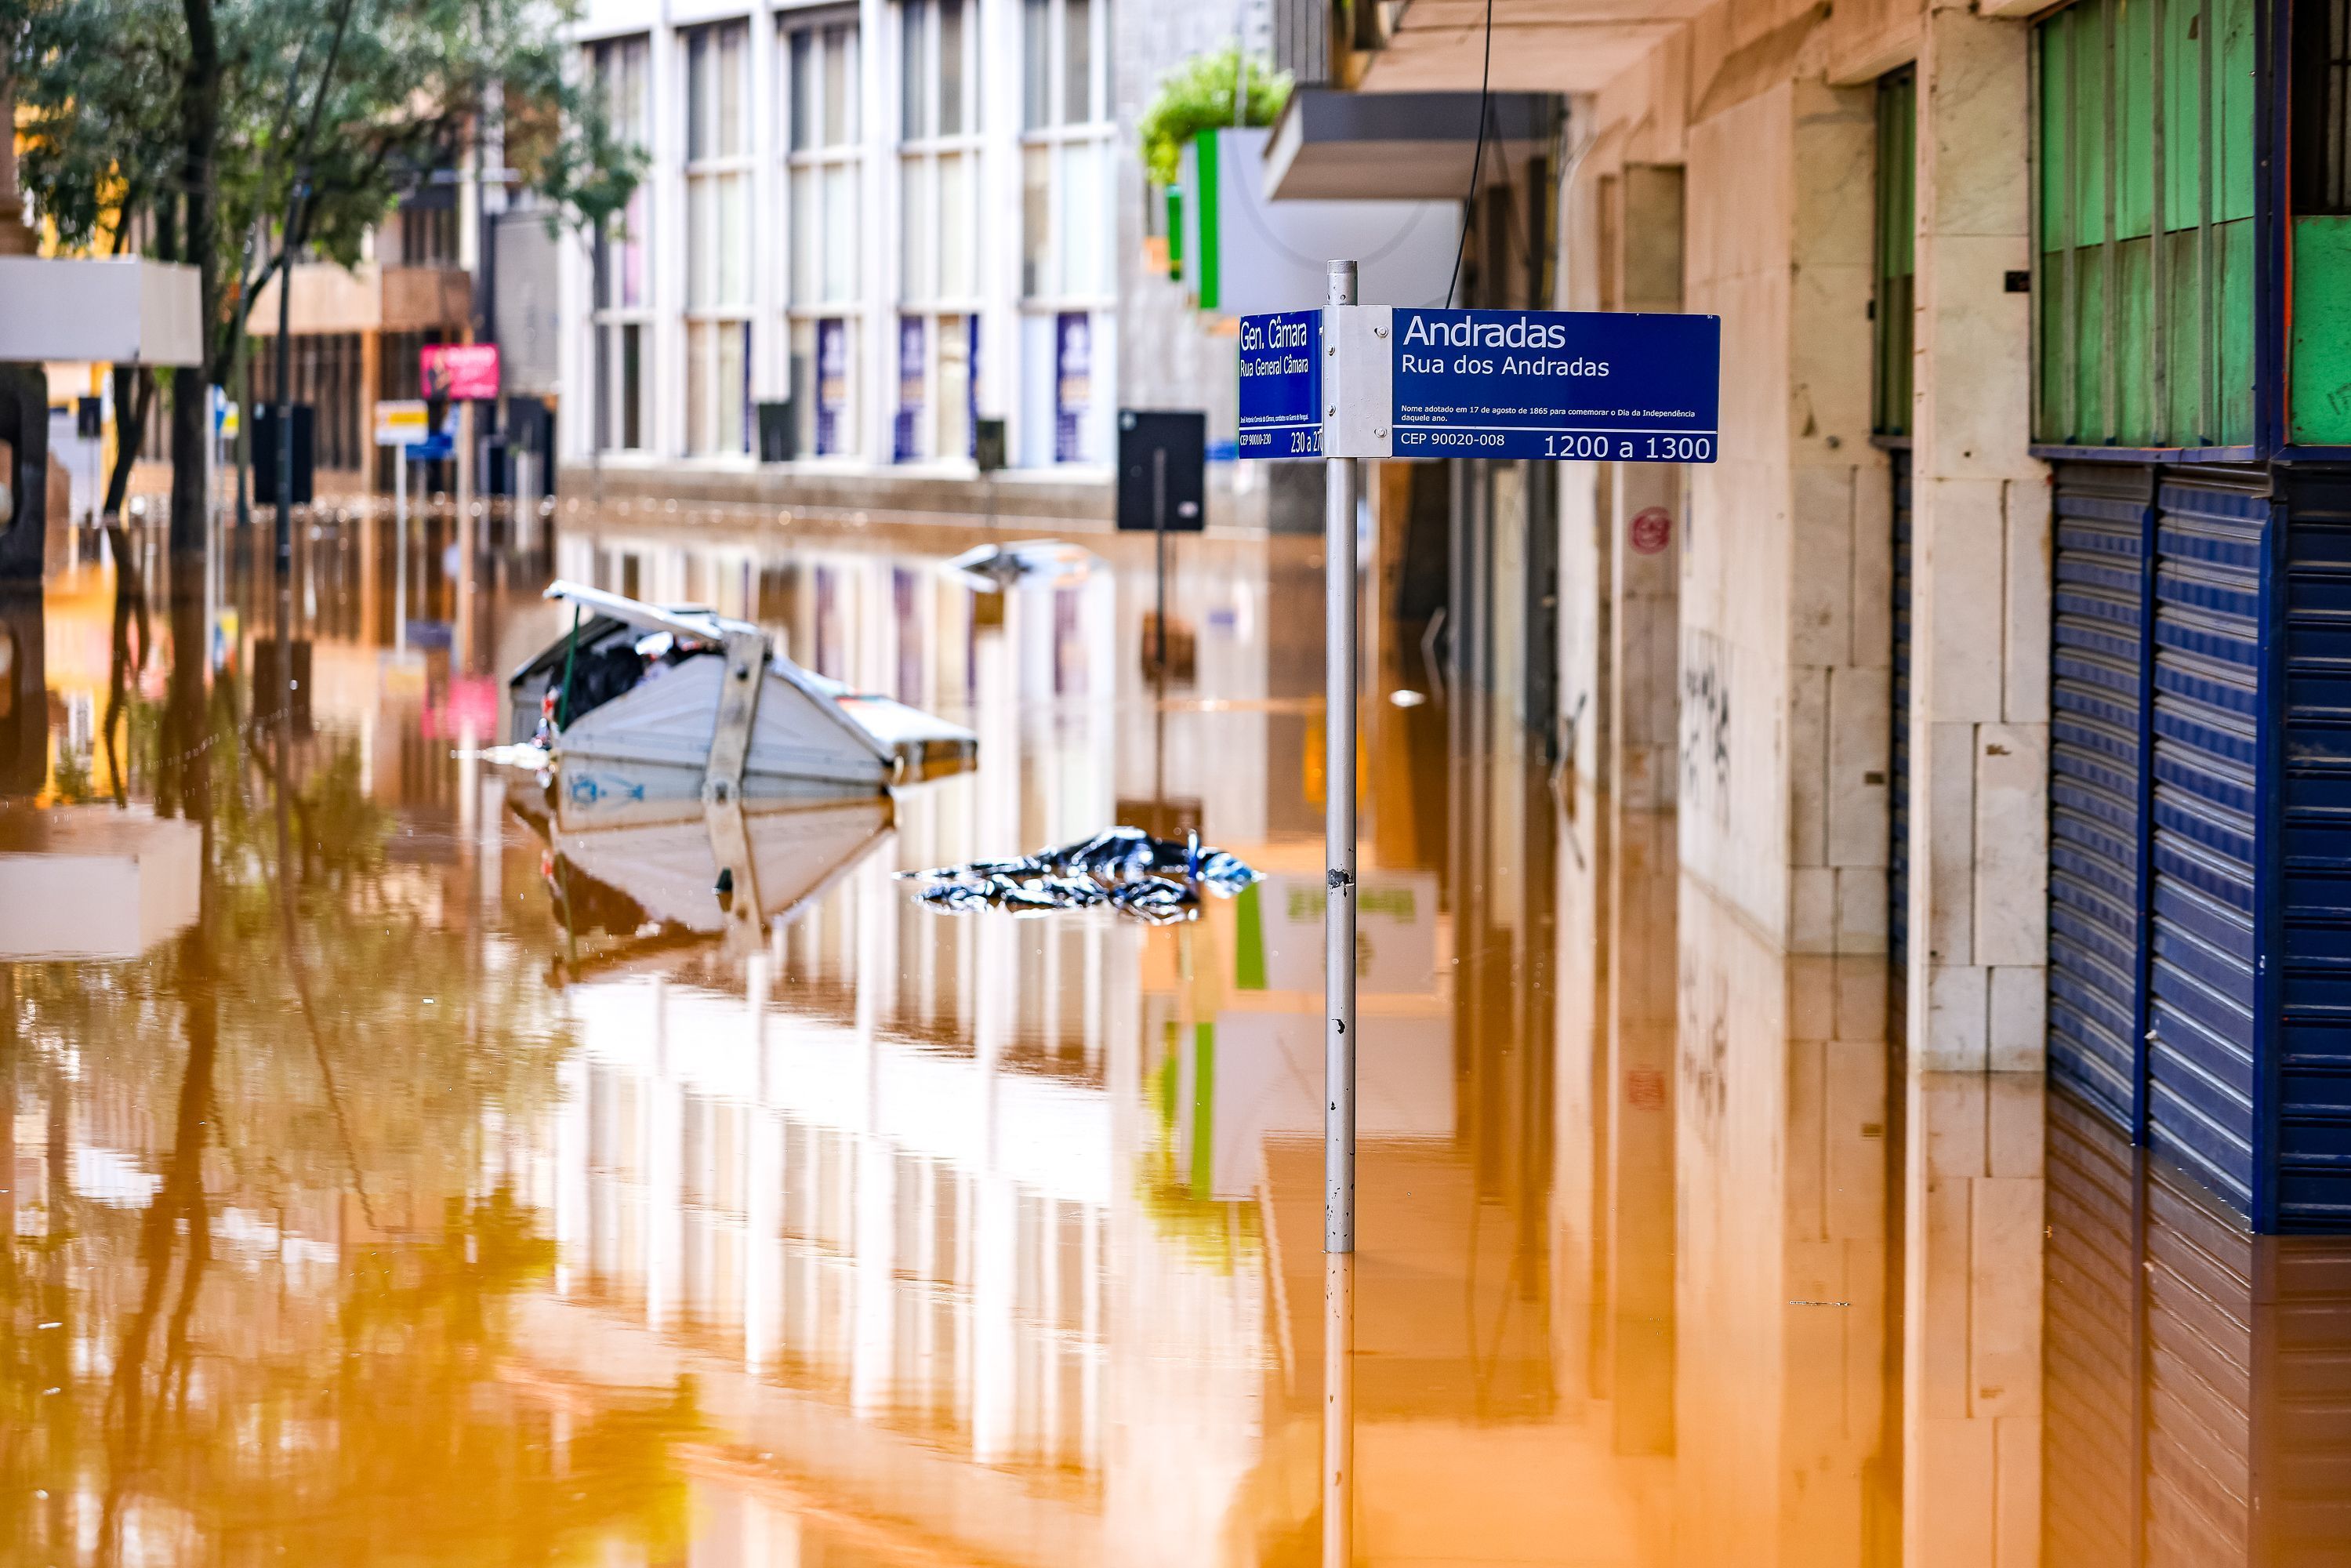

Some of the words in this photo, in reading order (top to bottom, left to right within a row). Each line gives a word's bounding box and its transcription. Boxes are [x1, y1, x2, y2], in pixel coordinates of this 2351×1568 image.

[1240, 321, 1264, 351] Gen.
[1268, 315, 1307, 349] Câmara
[1402, 315, 1566, 349] Andradas
[1240, 359, 1254, 377] Rua
[1255, 356, 1282, 376] General
[1283, 354, 1308, 375] Câmara
[1402, 354, 1444, 374] Rua
[1453, 354, 1493, 375] dos
[1501, 356, 1609, 377] Andradas
[1401, 405, 1423, 413] Nome
[1492, 407, 1517, 416] agosto
[1642, 409, 1696, 418] Independência
[1401, 414, 1430, 423] daquele
[1239, 434, 1248, 446] CEP
[1249, 433, 1272, 446] 90010-230
[1290, 431, 1305, 453] 230
[1307, 436, 1312, 452] a
[1401, 433, 1427, 445] CEP
[1431, 433, 1505, 446] 90020-008
[1544, 435, 1609, 458] 1200
[1619, 441, 1634, 458] a
[1646, 437, 1711, 459] 1300
